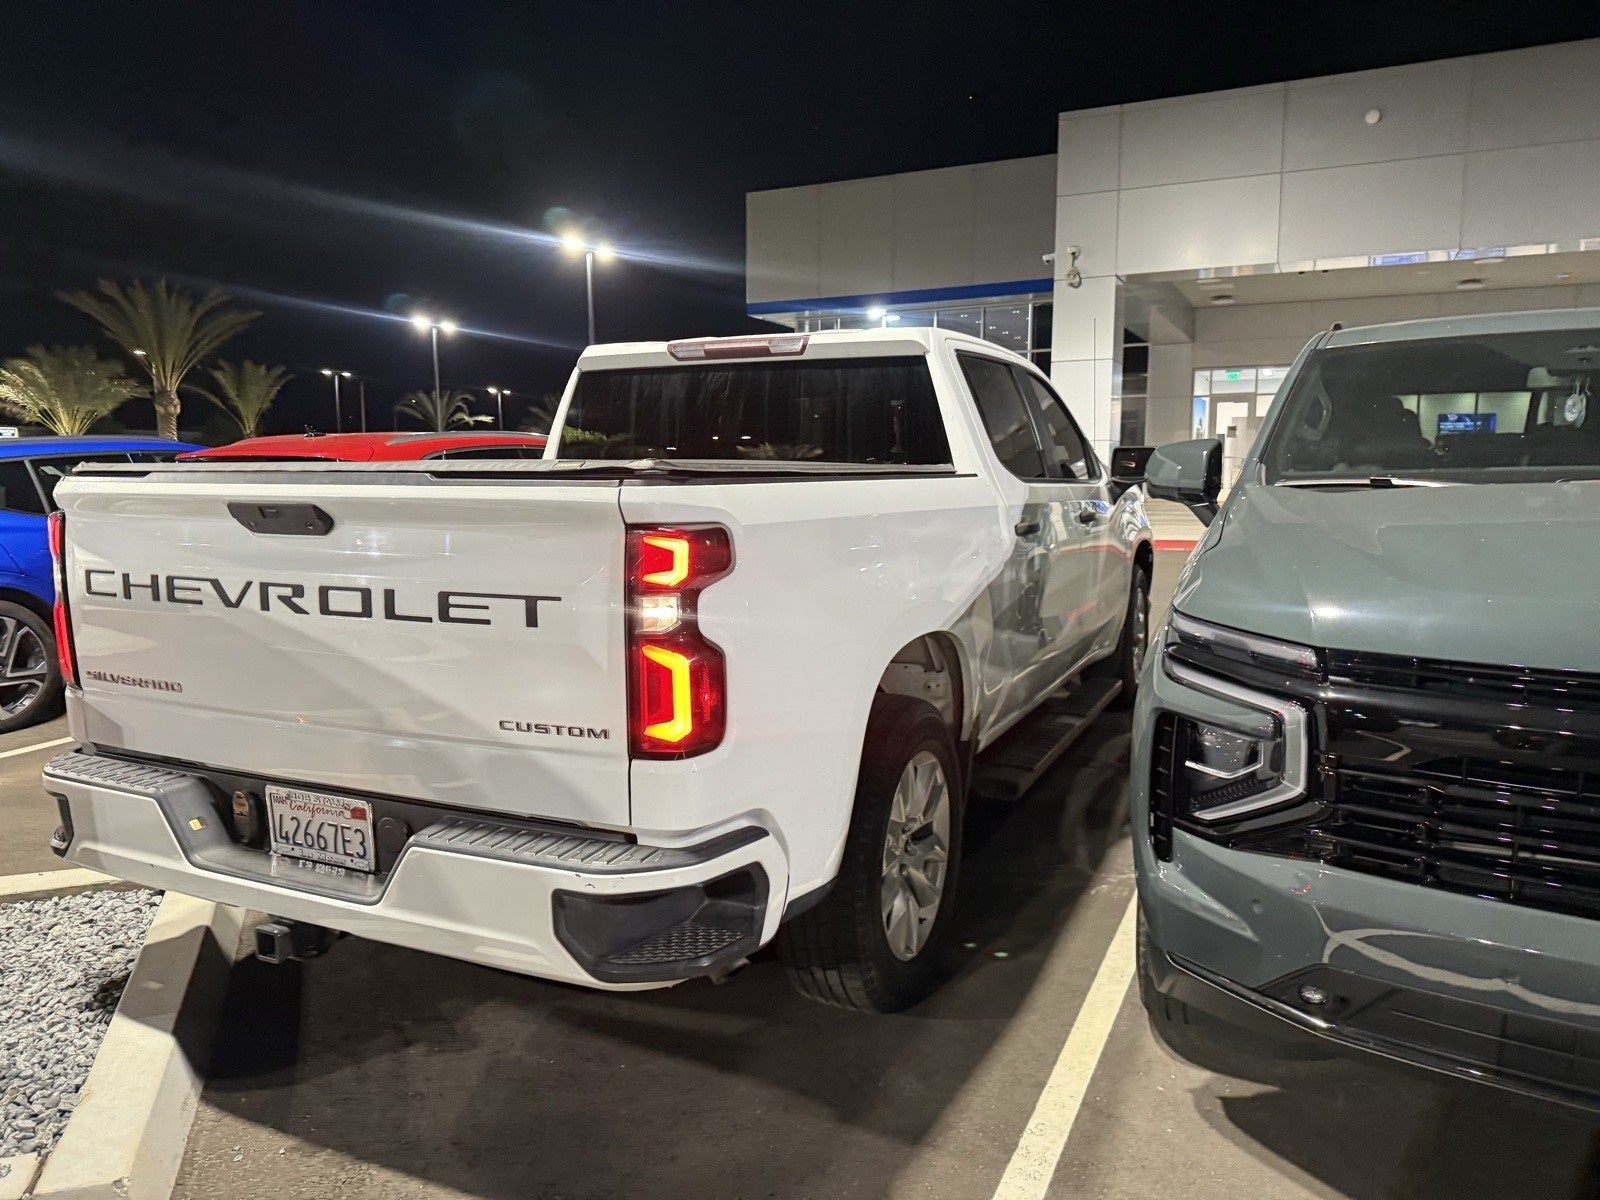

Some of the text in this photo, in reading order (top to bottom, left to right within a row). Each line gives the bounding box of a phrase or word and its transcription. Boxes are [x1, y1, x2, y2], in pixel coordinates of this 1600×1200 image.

[85, 569, 561, 628] CHEVROLET
[86, 670, 183, 693] SILVERADO
[499, 719, 610, 740] CUSTOM
[289, 800, 351, 819] California
[279, 813, 367, 859] 42667E3
